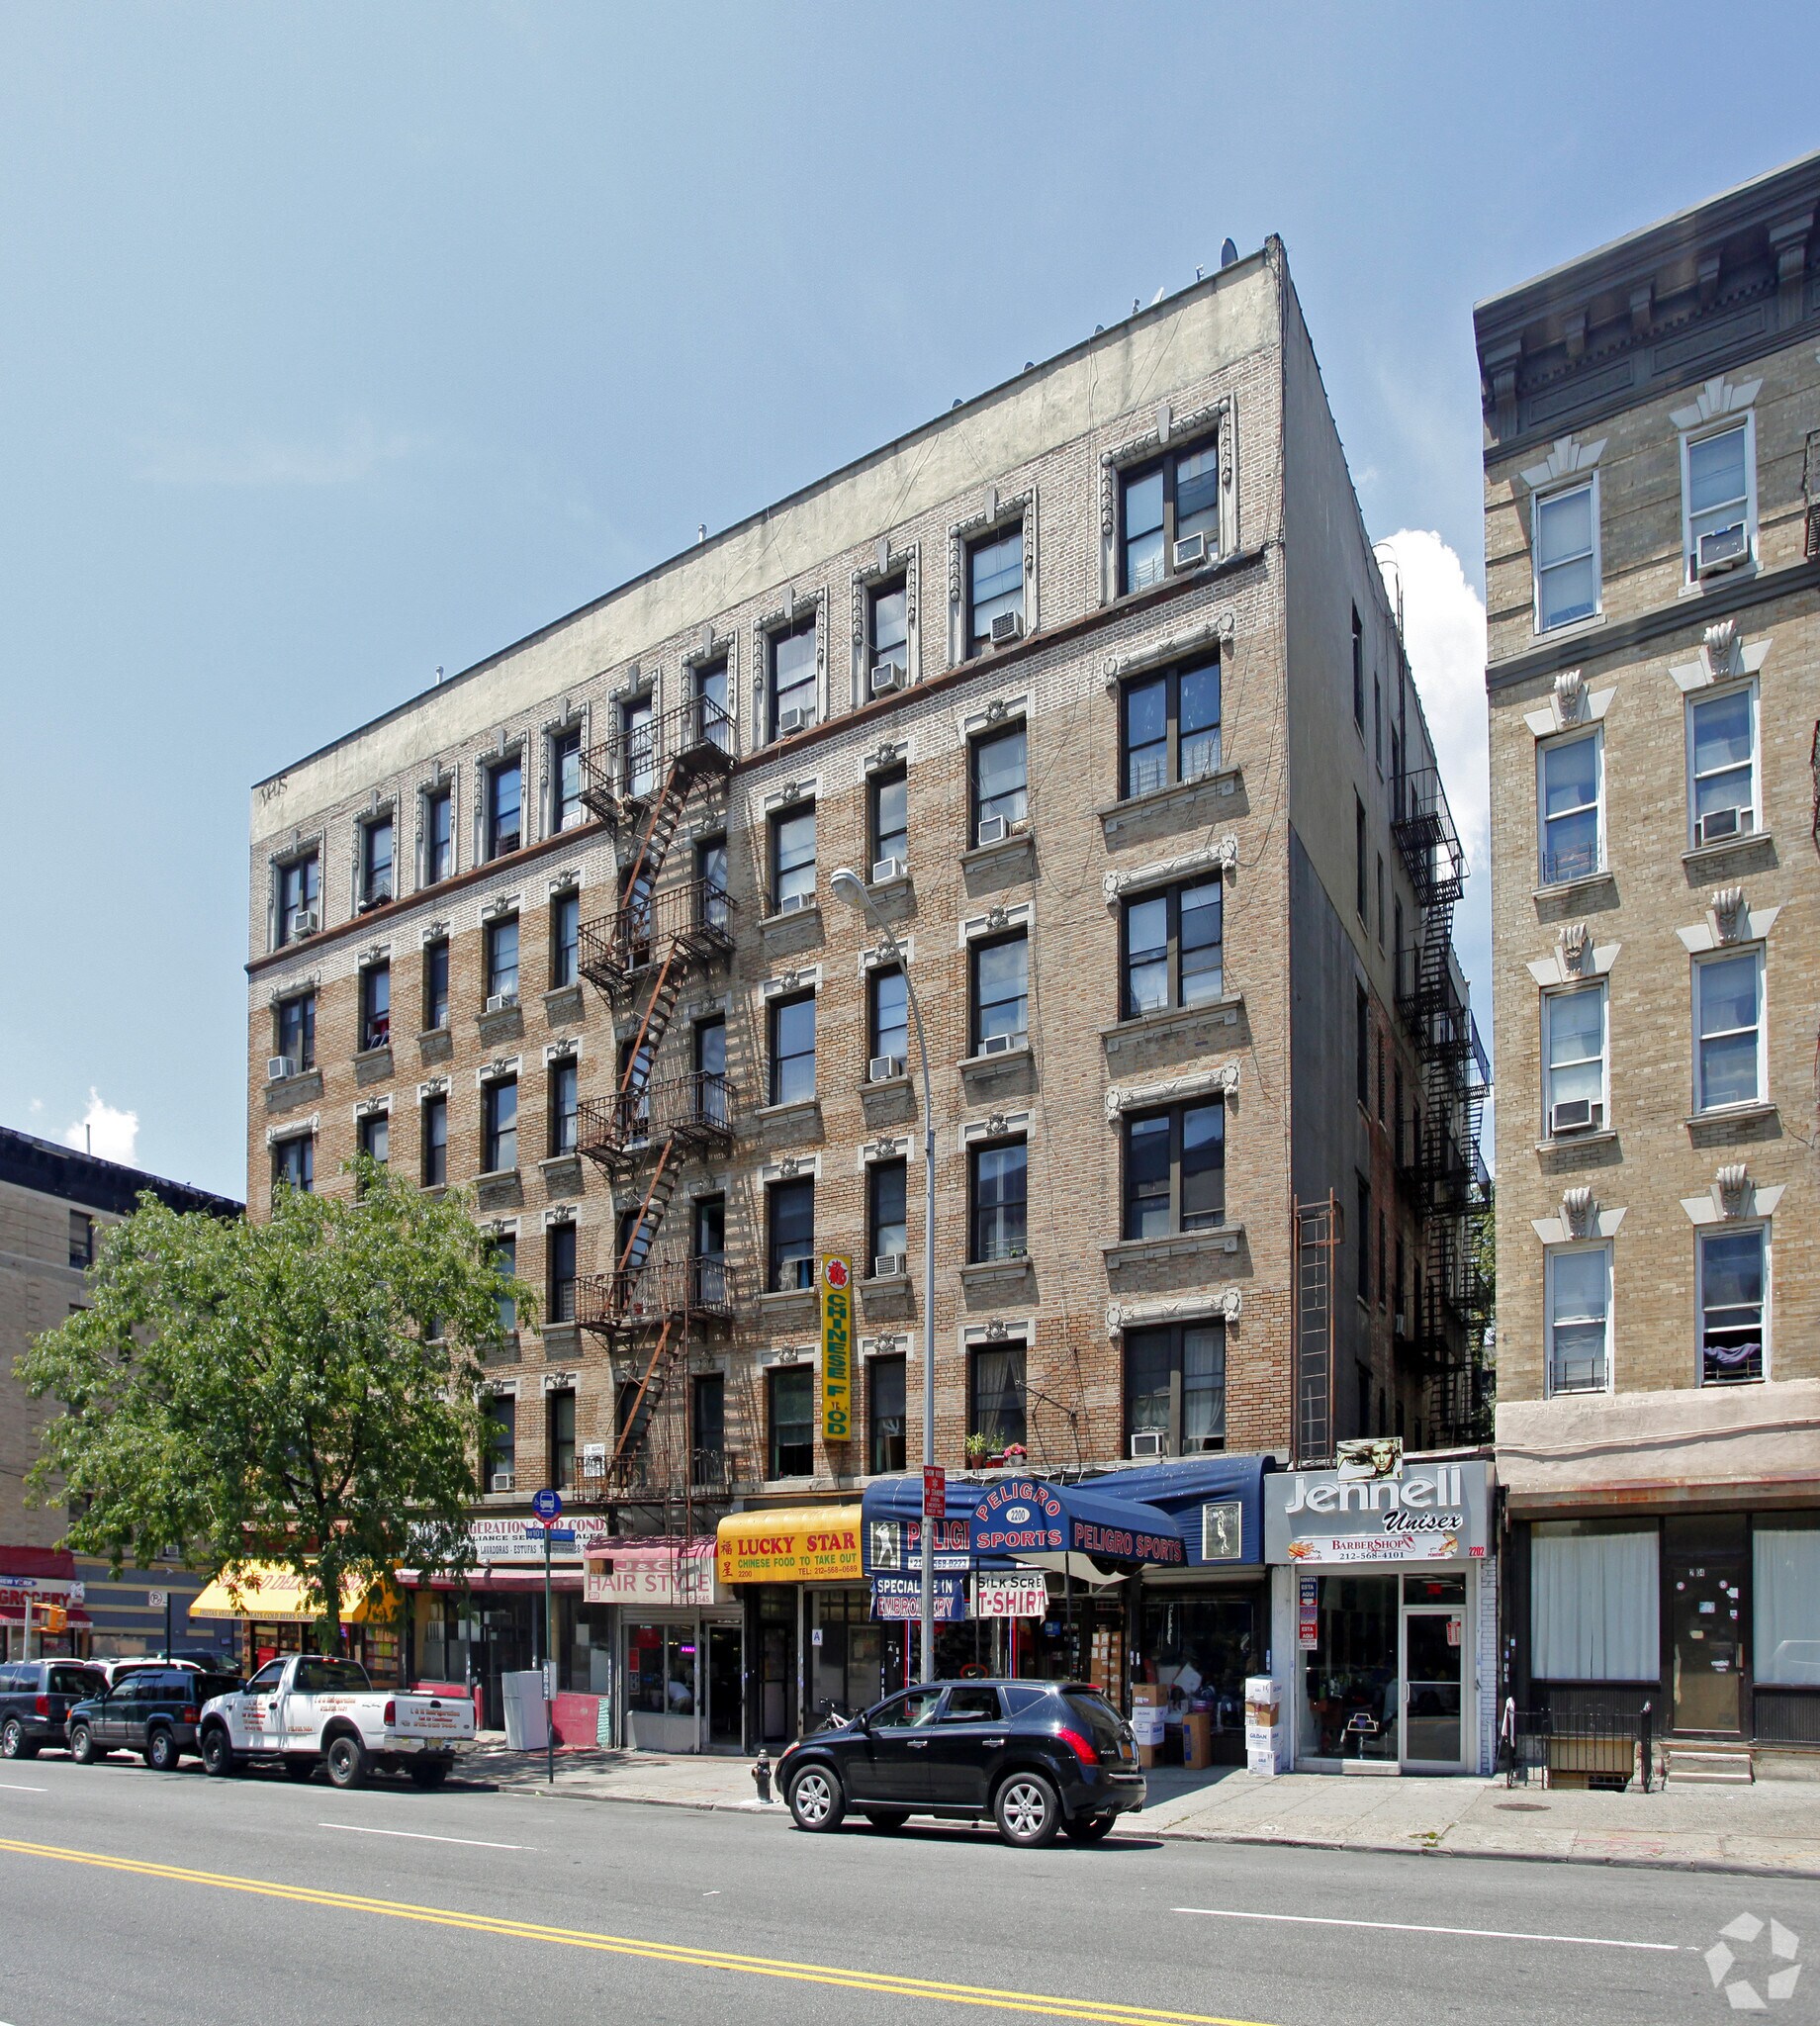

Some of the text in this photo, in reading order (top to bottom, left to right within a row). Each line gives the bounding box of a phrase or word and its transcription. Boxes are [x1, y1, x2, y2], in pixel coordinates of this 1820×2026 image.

[827, 1293, 847, 1381] CHINESE
[827, 1384, 847, 1434] FOD
[1285, 1465, 1461, 1514] Jennell
[975, 1482, 1060, 1521] PELIGRO
[1010, 1510, 1026, 1521] 2200
[1383, 1511, 1462, 1532] Unisex
[526, 1529, 543, 1538] M101
[976, 1529, 1062, 1548] SPORTS
[1074, 1522, 1182, 1562] PELIGRO SPORTS
[481, 1544, 537, 1554] LAVADORAS ESTUFAS
[738, 1532, 856, 1556] LUCKY STAR
[1469, 1546, 1485, 1557] 2202
[738, 1553, 858, 1569] CHINESE FOOD TO TAKE OUT
[1339, 1551, 1405, 1560] 212-568-4101
[588, 1575, 636, 1592] HAIR
[941, 1579, 953, 1594] IN
[0, 1589, 71, 1609] GROCERY
[814, 1631, 821, 1641] A
